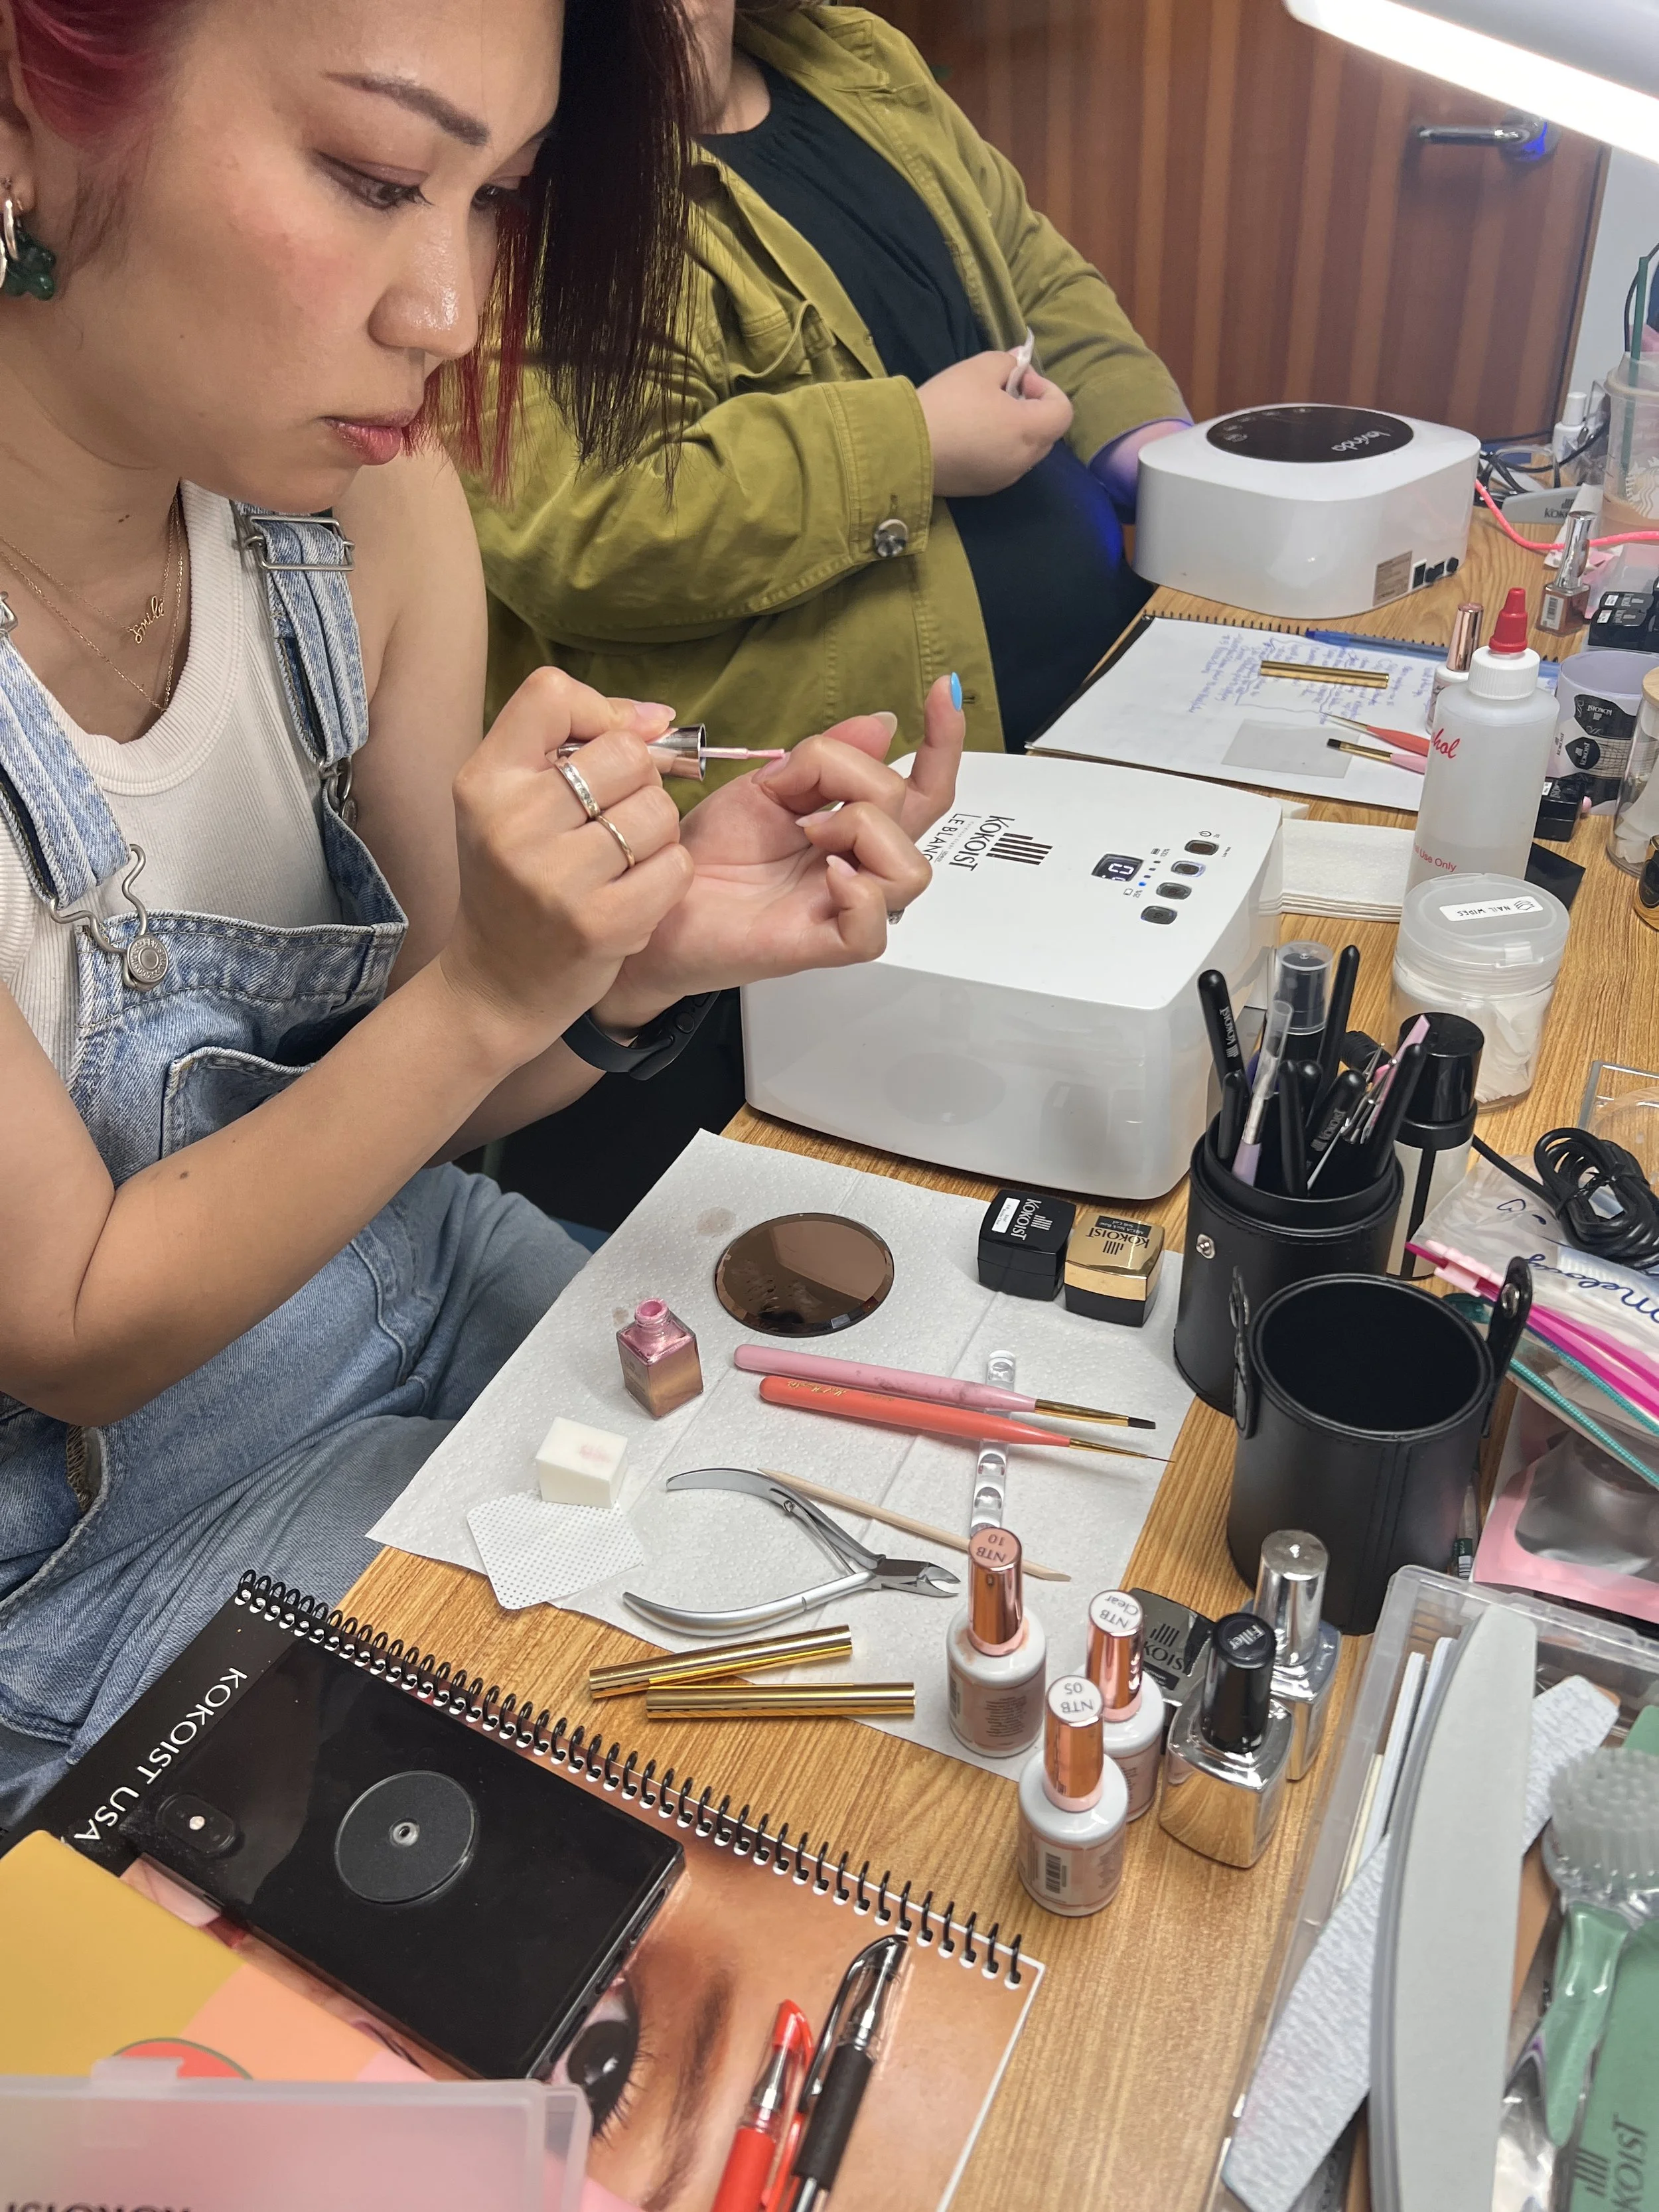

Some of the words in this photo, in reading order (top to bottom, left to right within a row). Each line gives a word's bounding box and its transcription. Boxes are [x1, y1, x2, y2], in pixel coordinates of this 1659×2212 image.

[130, 595, 165, 644] smile
[1587, 704, 1613, 717] KOKOIST
[948, 815, 1016, 871] KOKOIST
[1419, 848, 1433, 863] Use
[1435, 857, 1457, 873] Only
[1457, 908, 1486, 917] WIPES
[1010, 1198, 1043, 1240] KOKOIST
[1086, 1227, 1150, 1249] KOKOIST
[987, 1534, 1005, 1546] 10
[975, 1546, 1006, 1563] NTB
[1104, 1595, 1139, 1617] Clear
[1099, 1609, 1129, 1628] NTB
[1229, 1624, 1266, 1651] Filler
[1064, 1682, 1083, 1695] 05
[1060, 1698, 1094, 1714] NTB
[137, 1667, 248, 1785] KOKOIST
[73, 1786, 140, 1840] USA
[1609, 2110, 1649, 2212] KOIST
